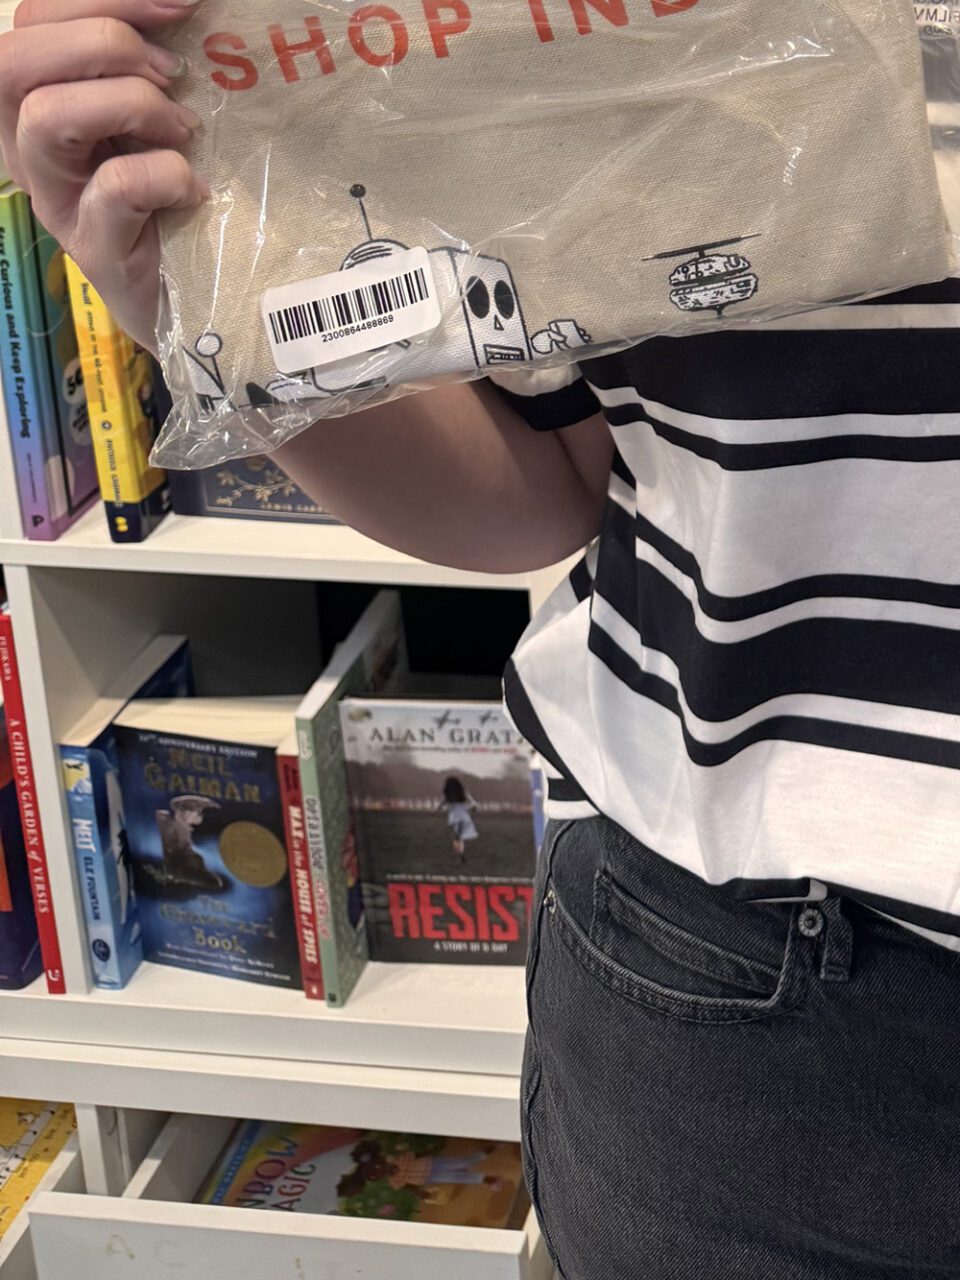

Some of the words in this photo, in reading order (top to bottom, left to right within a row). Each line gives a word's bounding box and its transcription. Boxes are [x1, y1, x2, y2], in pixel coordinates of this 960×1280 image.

[322, 314, 394, 343] 2300864488869
[369, 727, 435, 744] ALAN
[450, 728, 523, 744] GRAT
[10, 729, 30, 788] CHILD'S
[20, 791, 39, 846] GARDEN
[30, 866, 49, 914] VERSES
